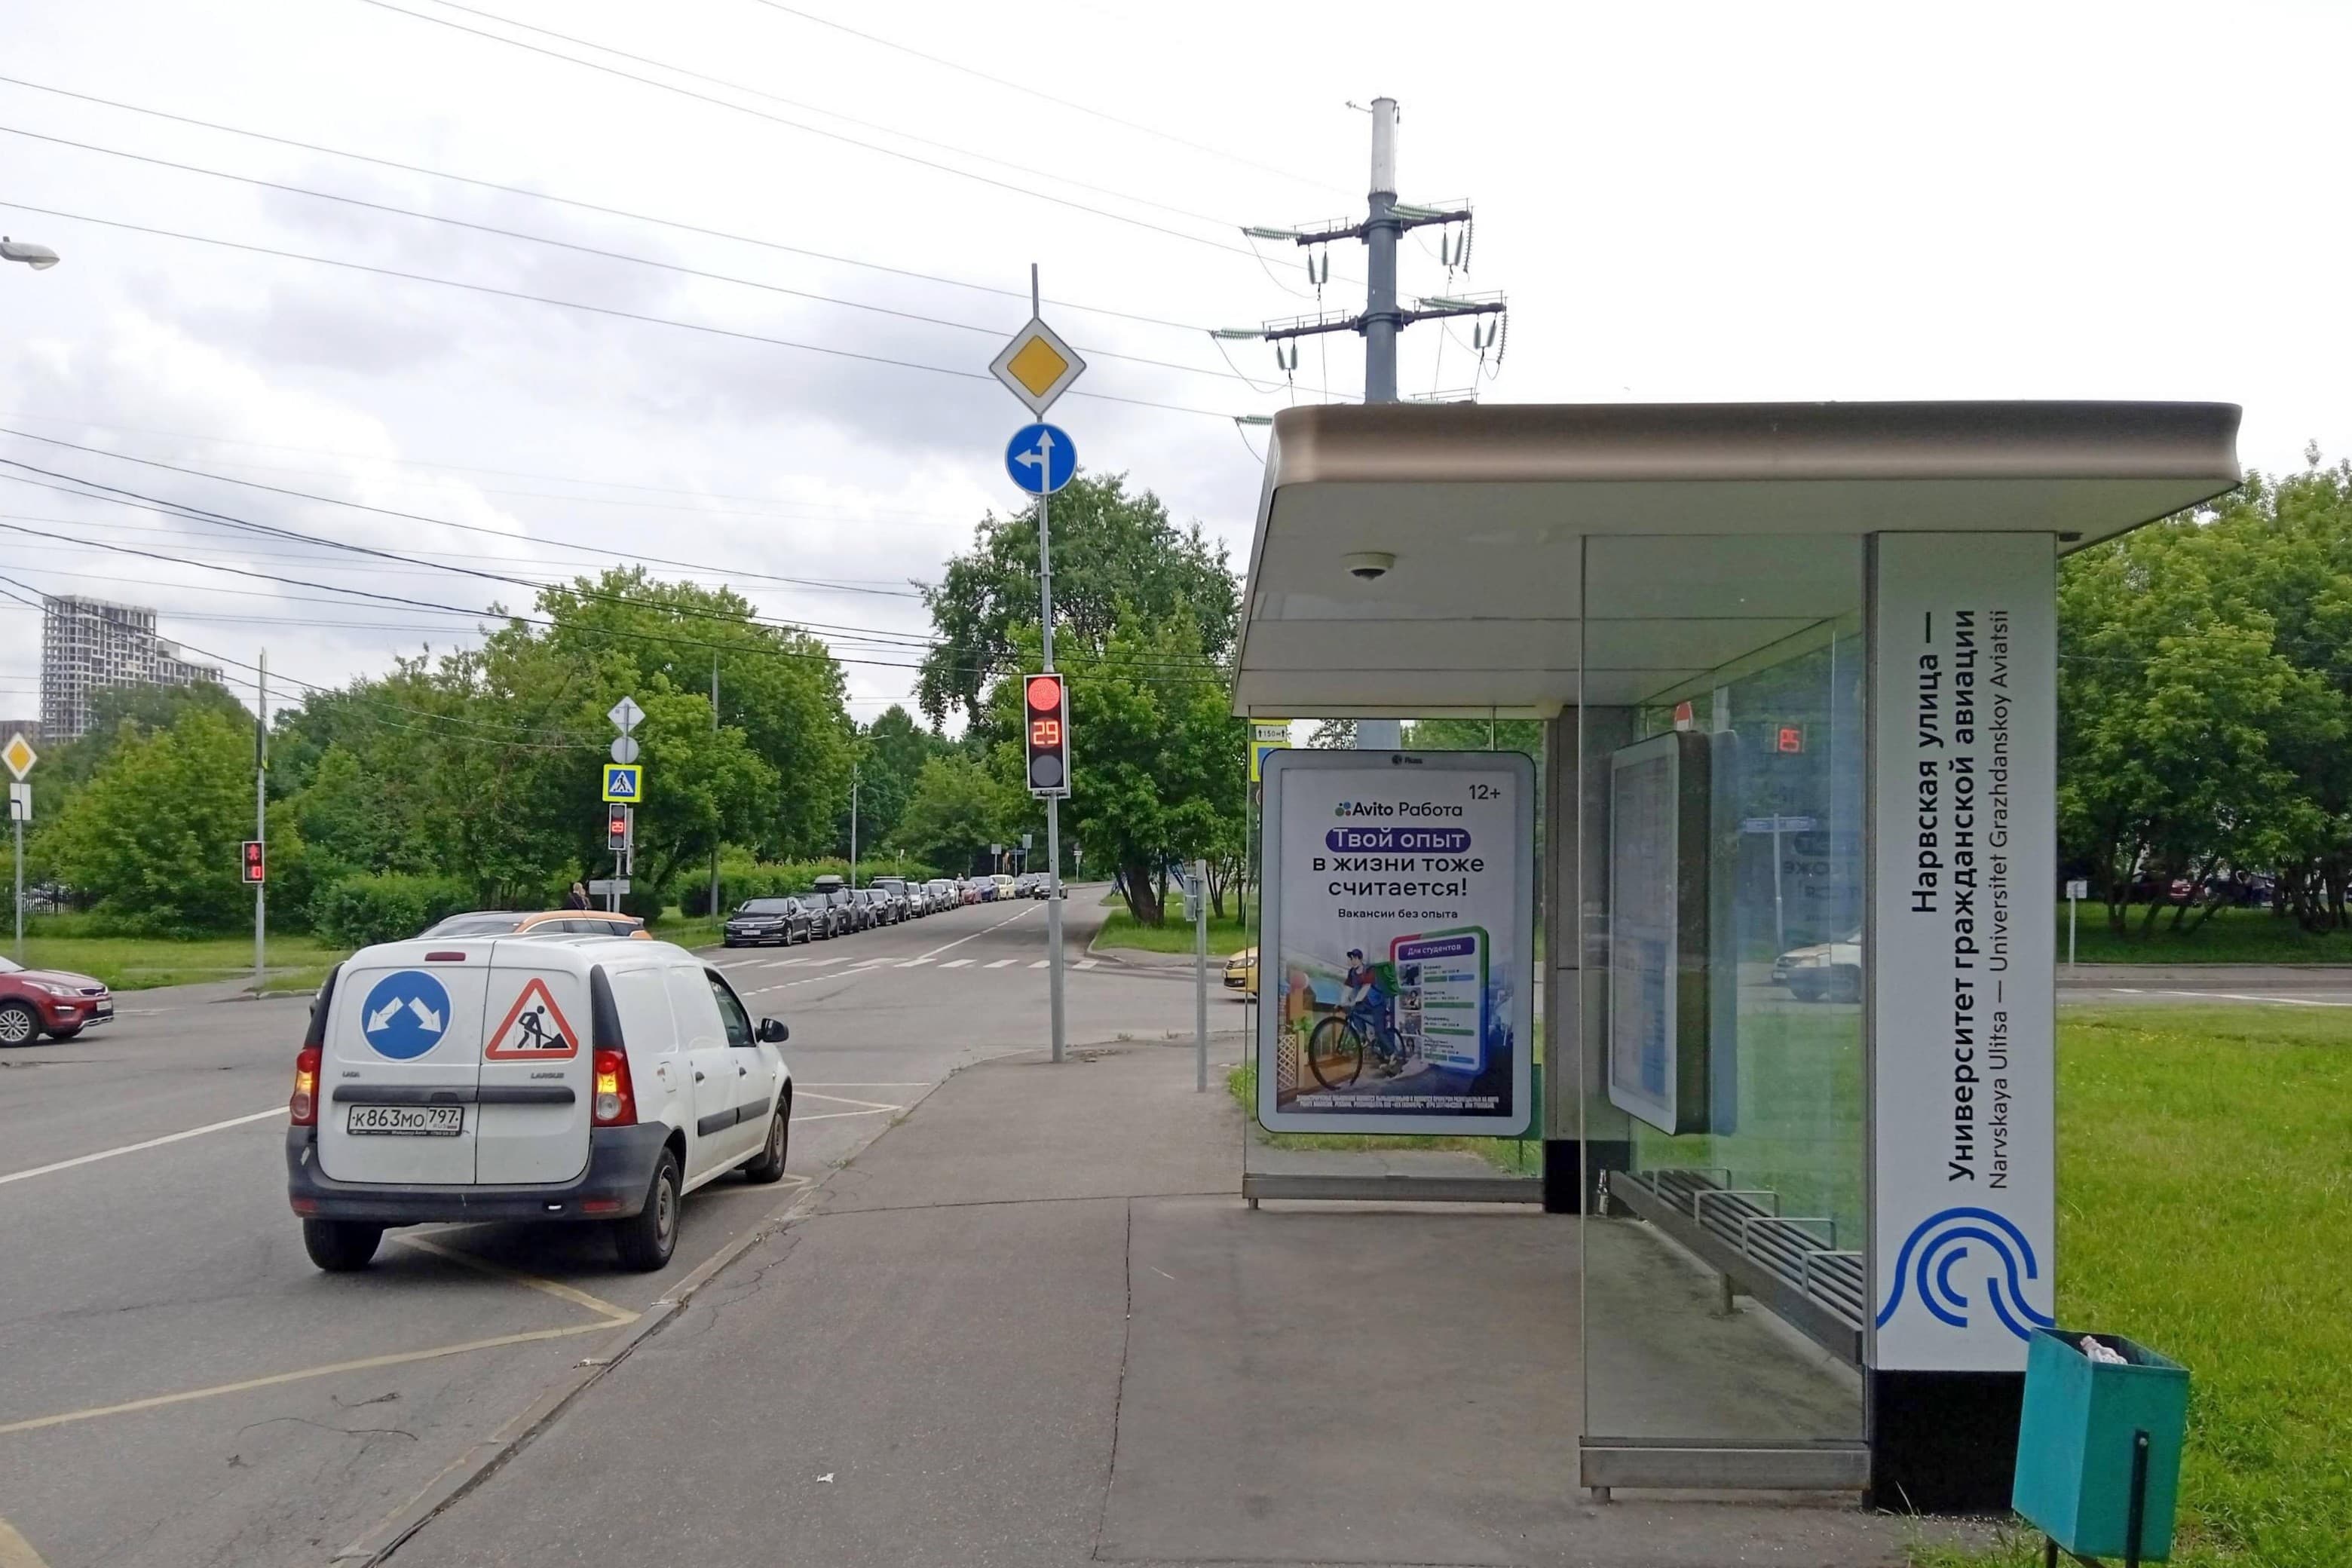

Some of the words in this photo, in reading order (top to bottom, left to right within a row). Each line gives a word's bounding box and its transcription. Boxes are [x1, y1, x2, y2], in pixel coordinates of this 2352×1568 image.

[1955, 611, 1979, 745] авиации
[1989, 611, 2009, 688] Aviatsii
[1033, 721, 1059, 745] 29
[1919, 654, 1944, 749] улица
[1468, 784, 1501, 800] 12+
[1988, 694, 2012, 848] Grazhdanskoy
[1333, 827, 1393, 848] Твой
[1400, 832, 1465, 848] опыт
[1352, 801, 1394, 816] Avito
[1398, 801, 1462, 816] Работа
[1911, 761, 1944, 913] Нарвская
[1312, 857, 1326, 871] в
[1333, 857, 1415, 872] жизни
[1422, 857, 1484, 873] тоже
[1328, 877, 1467, 897] считается!
[1948, 757, 1980, 969] гражданской
[1338, 908, 1395, 919] Вакансии
[1398, 908, 1419, 919] без
[1421, 910, 1458, 920] опыта
[1989, 853, 2009, 972] Universitet
[1407, 947, 1421, 956] Для
[1423, 944, 1461, 954] студентов
[1988, 1011, 2008, 1070] Ulitsa
[1948, 977, 1980, 1182] Университет
[1988, 1078, 2012, 1190] Narvskaya
